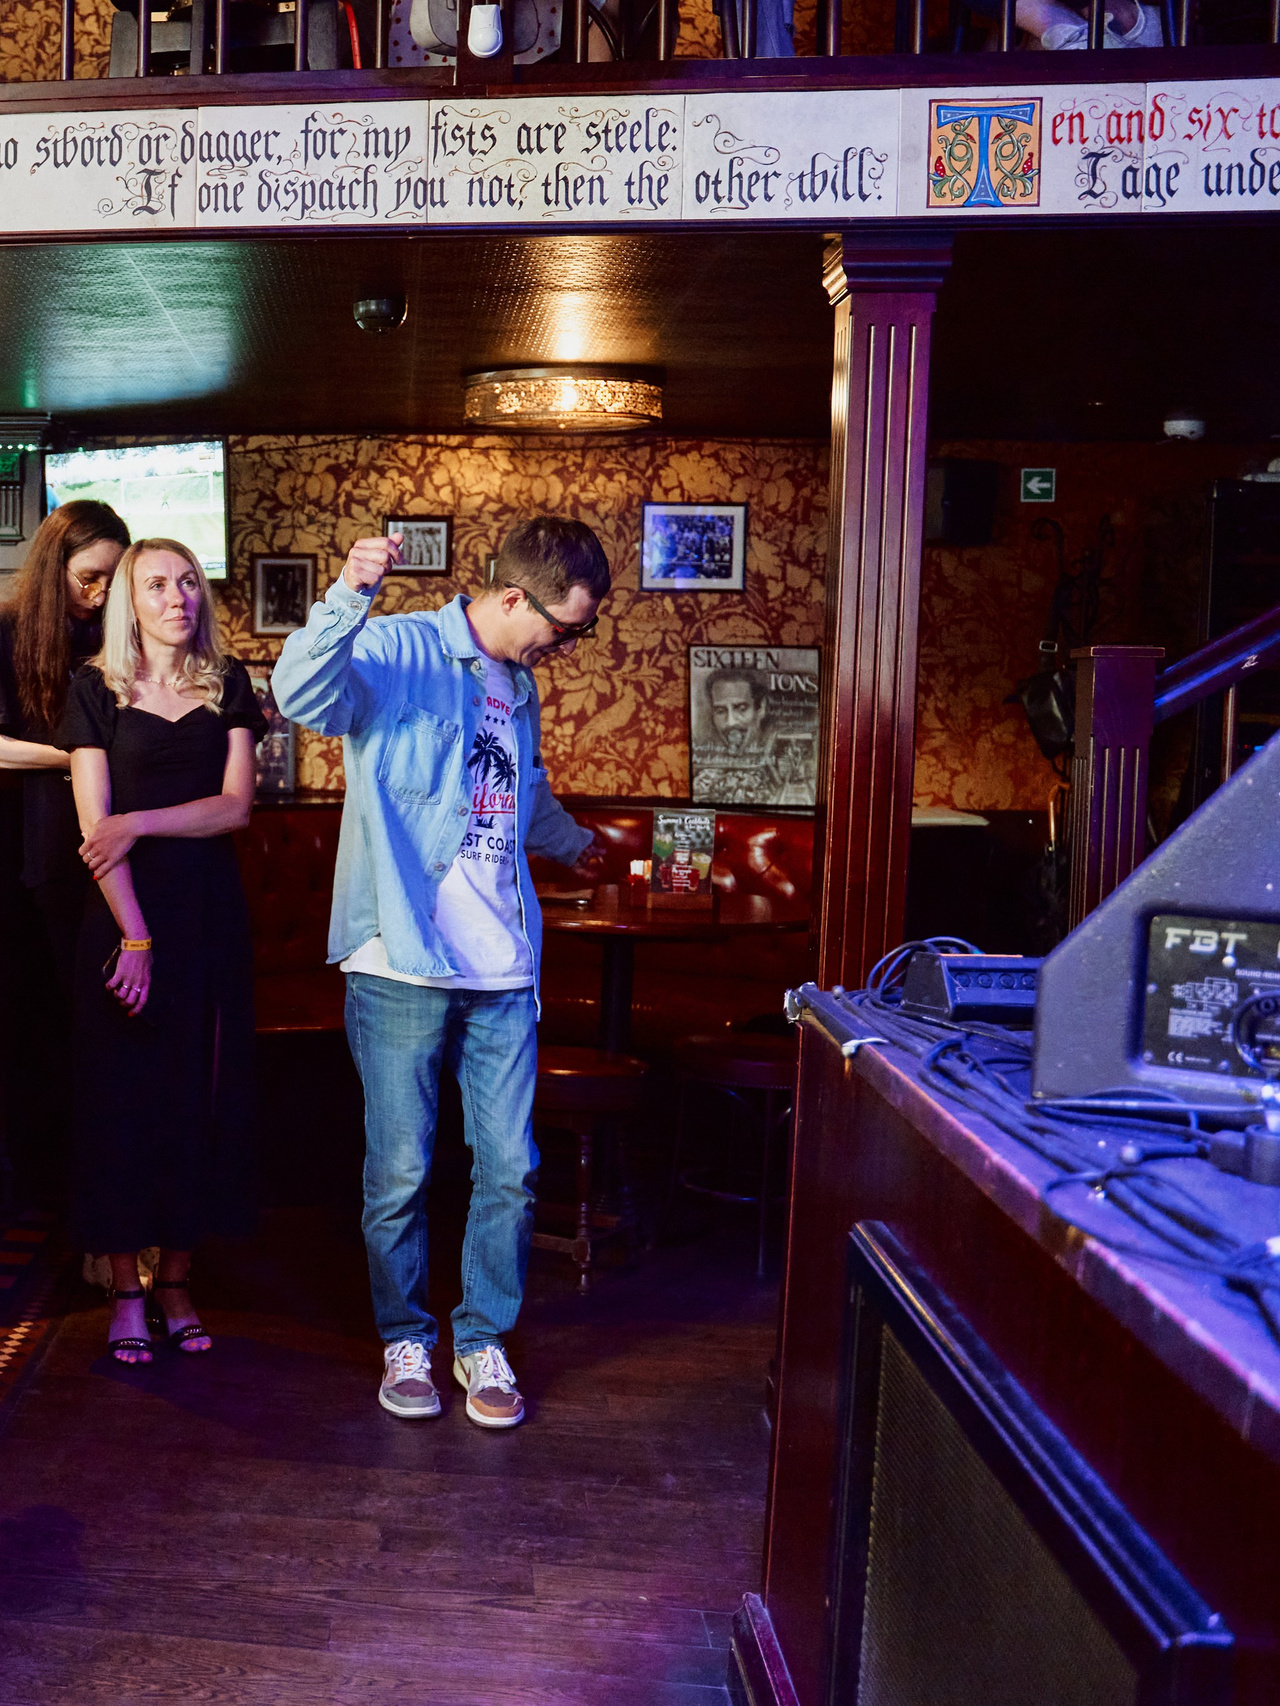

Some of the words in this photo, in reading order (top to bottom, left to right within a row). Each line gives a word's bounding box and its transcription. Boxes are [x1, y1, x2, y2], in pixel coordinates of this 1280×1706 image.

[32, 124, 123, 169] sword
[138, 133, 171, 166] or
[181, 120, 283, 172] dagger,
[300, 112, 347, 169] for
[363, 126, 411, 172] my
[431, 109, 497, 167] fists
[516, 120, 567, 155] are
[581, 107, 678, 154] steele:
[1106, 93, 1165, 144] and
[1183, 103, 1239, 151] six
[198, 180, 245, 213] one
[257, 164, 378, 220] dispatch
[392, 175, 449, 217] you
[467, 172, 524, 211] not,
[542, 162, 609, 212] then
[623, 160, 670, 210] the
[695, 157, 782, 211] other
[794, 147, 882, 203] will.
[1121, 161, 1180, 208] age
[693, 648, 780, 670] SIXTEEN
[767, 672, 819, 694] TONS
[460, 849, 482, 861] SURF
[1165, 927, 1247, 955] FBT
